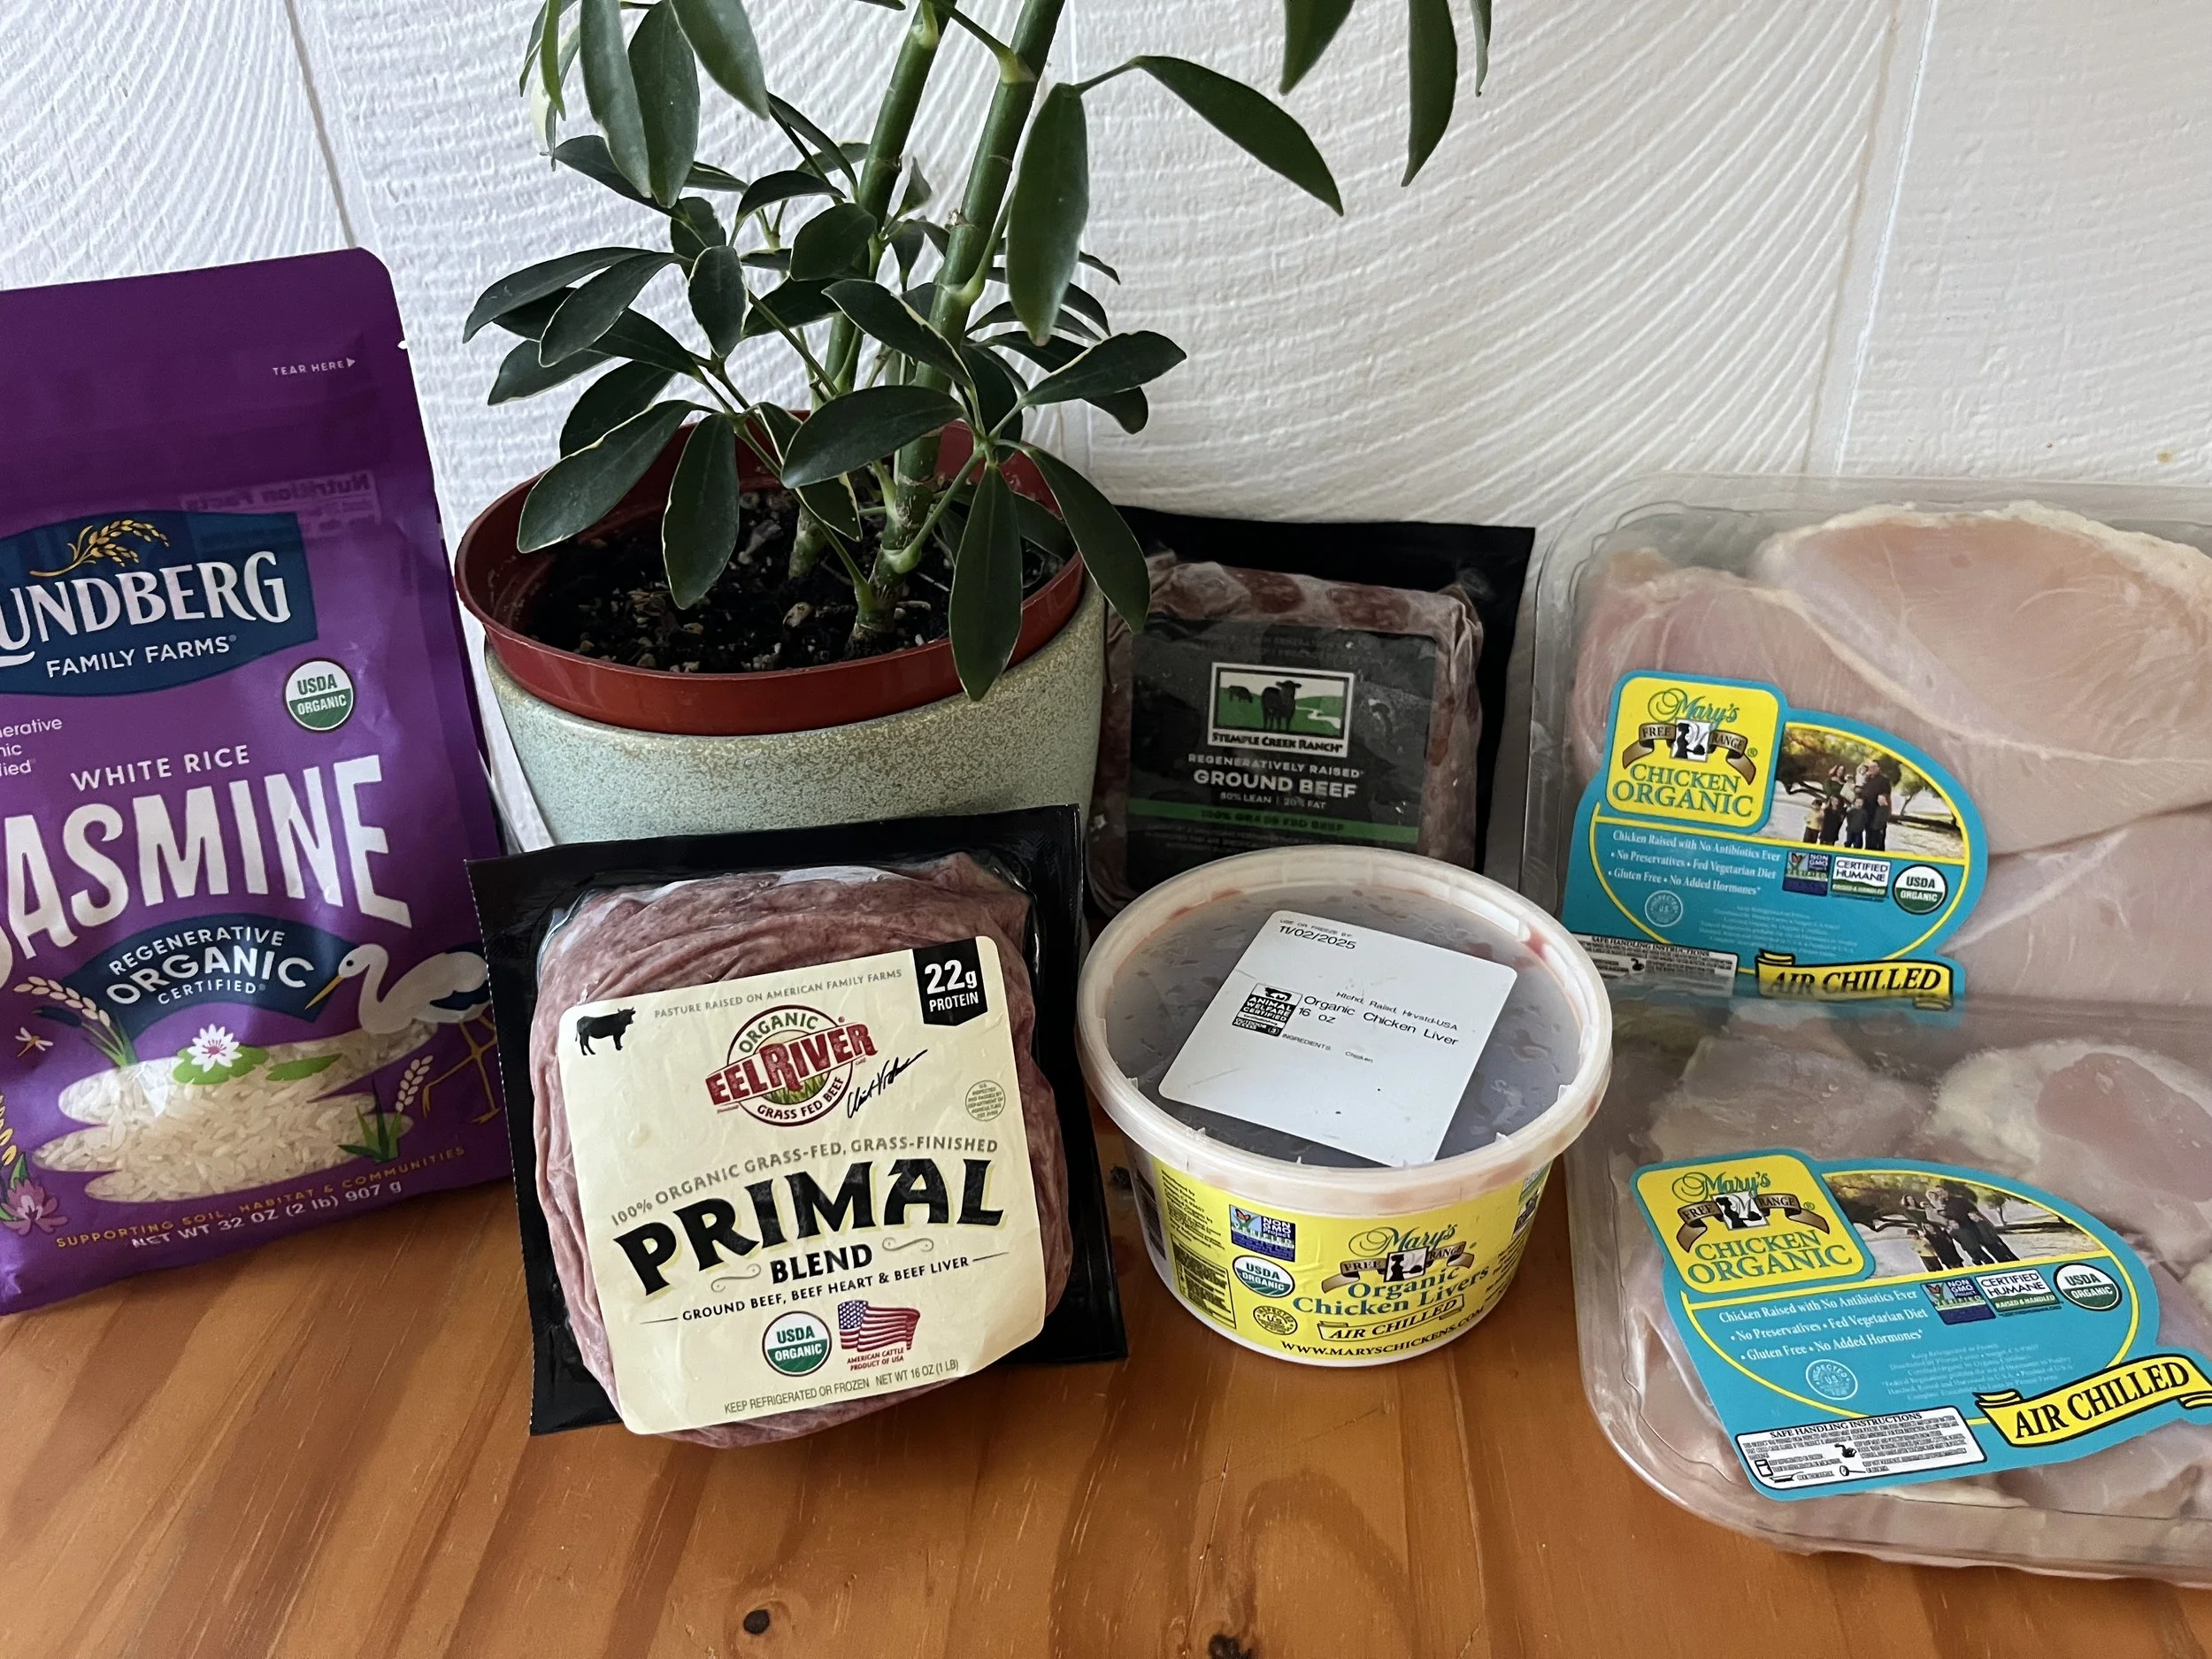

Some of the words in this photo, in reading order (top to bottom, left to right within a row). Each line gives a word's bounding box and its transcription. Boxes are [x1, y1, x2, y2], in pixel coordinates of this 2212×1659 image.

[273, 365, 306, 375] TEAR
[311, 360, 344, 372] HERE
[0, 551, 291, 665] UNDBERG
[46, 649, 134, 678] FAMILY
[146, 636, 230, 663] FARMS
[297, 673, 337, 695] USDA
[297, 695, 347, 715] ORGANIC
[1647, 687, 1740, 730] Mary's
[1212, 732, 1259, 746] STEMPLE
[1262, 736, 1296, 749] CREEK
[1642, 726, 1671, 738] FREE
[71, 758, 172, 791] WHITE
[184, 745, 250, 772] RICE
[1188, 753, 1305, 772] REGENERATIVELY
[1309, 764, 1360, 779] RAISED
[1630, 764, 1741, 794] CHICKEN
[1194, 769, 1293, 792] GROUND
[1299, 779, 1358, 798] BEEF
[1612, 780, 1754, 818] ORGANIC
[1613, 830, 1647, 843] Chicken
[1648, 834, 1677, 849] Raised
[1677, 839, 1698, 850] with
[1699, 841, 1711, 851] No
[1713, 843, 1760, 859] Antibiotics
[1761, 850, 1781, 862] Ever
[1617, 850, 1629, 860] No
[1630, 852, 1686, 867] Preservatives
[1692, 858, 1709, 869] Fed
[1709, 861, 1756, 877] Vegetarian
[1757, 867, 1777, 879] Diet
[1836, 870, 1885, 882] HUMANE
[1837, 859, 1888, 872] CERTIFIED
[1613, 867, 1642, 881] Gluten
[1643, 872, 1663, 884] Free
[1669, 874, 1681, 886] No
[1683, 877, 1711, 889] Added
[1906, 876, 1936, 888] USDA
[1901, 890, 1938, 902] ORGANIC
[109, 926, 285, 975] REGENERATIVE
[1279, 926, 1357, 949] 11/02/2025
[106, 945, 314, 1004] ORGANIC
[925, 959, 977, 995] 22g
[1822, 968, 1941, 991] CHILLED
[655, 1002, 702, 1018] PASTURE
[705, 996, 742, 1010] RAISED
[747, 993, 763, 1003] ON
[766, 982, 823, 1000] AMERICAN
[827, 976, 864, 990] FAMILY
[867, 969, 902, 982] FARMS
[929, 991, 979, 1012] PROTEIN
[1248, 996, 1292, 1012] ANIMAL
[1243, 1006, 1286, 1022] CERTIFIED
[1247, 1001, 1290, 1017] WELFARE
[1298, 1007, 1312, 1017] 16
[1303, 995, 1356, 1016] Organic
[1363, 1011, 1417, 1033] Chicken
[1423, 1028, 1459, 1046] Liver
[739, 1012, 818, 1053] ORGANIC
[757, 1103, 797, 1120] GRASS
[801, 1101, 823, 1117] FED
[824, 1076, 844, 1102] BEEF
[611, 1198, 653, 1226] 100%
[655, 1165, 740, 1205] ORGANIC
[744, 1142, 847, 1173] GRASS-FED,
[850, 1135, 998, 1153] GRASS-FINISHED
[1672, 1171, 1770, 1202] Mary's
[57, 1220, 174, 1248] SUPPORTING
[239, 1187, 315, 1213] HABITAT
[342, 1146, 466, 1189] COMMUNITIES
[1758, 1197, 1796, 1208] RANGE
[131, 1231, 171, 1248] NET
[178, 1222, 210, 1240] WT
[218, 1217, 244, 1232] 32
[250, 1208, 280, 1224] OZ
[311, 1194, 339, 1213] lb)
[344, 1184, 381, 1203] 907
[390, 1179, 403, 1194] g
[1263, 1217, 1290, 1229] NON
[1683, 1204, 1714, 1220] FREE
[612, 1157, 1004, 1297] PRIMAL
[1263, 1223, 1291, 1234] GMO
[1348, 1224, 1457, 1257] Mary's
[1429, 1244, 1462, 1260] RANGE
[1694, 1229, 1822, 1261] CHICKEN
[770, 1243, 872, 1284] BLEND
[1246, 1261, 1280, 1280] USDA
[1343, 1261, 1382, 1271] FREE
[1687, 1244, 1853, 1284] ORGANIC
[682, 1300, 745, 1321] GROUND
[750, 1293, 787, 1309] BEEF,
[791, 1286, 823, 1302] BEEF
[828, 1275, 873, 1294] HEART
[879, 1272, 889, 1284] &
[894, 1265, 926, 1281] BEEF
[930, 1256, 969, 1274] LIVER
[1241, 1271, 1285, 1291] ORGANIC
[1293, 1296, 1409, 1316] Chicken
[1419, 1266, 1489, 1305] Livers
[1348, 1266, 1460, 1300] Organic
[1980, 1273, 2039, 1287] CERTIFIED
[1987, 1282, 2046, 1297] HUMANE
[2064, 1273, 2101, 1286] USDA
[2071, 1286, 2113, 1299] ORGANIC
[1718, 1307, 1764, 1323] Chicken
[1763, 1302, 1796, 1317] Raised
[1797, 1299, 1822, 1312] with
[1822, 1297, 1838, 1310] No
[1839, 1290, 1893, 1308] Antibiotics
[1895, 1288, 1918, 1302] Ever
[2024, 1294, 2055, 1304] HANDLED
[1281, 1306, 1485, 1356] WWW.MARYSCHICKENS.COM
[1329, 1329, 1366, 1340] AIR
[1372, 1299, 1457, 1336] CHILLED
[1735, 1329, 1753, 1341] No
[1754, 1321, 1822, 1339] Preservatives
[1828, 1317, 1848, 1330] Fed
[1849, 1310, 1904, 1327] Vegetarian
[1904, 1307, 1928, 1320] Diet
[776, 1325, 816, 1344] USDA
[1747, 1346, 1782, 1361] Gluten
[1783, 1343, 1808, 1356] Free
[1813, 1340, 1832, 1353] No
[1832, 1334, 1867, 1350] Added
[774, 1342, 823, 1362] ORGANIC
[846, 1351, 880, 1364] AMERICAN
[881, 1347, 904, 1358] CATTLE
[850, 1360, 880, 1371] PRODUCT
[891, 1355, 904, 1363] USA
[724, 1401, 748, 1414] KEEP
[749, 1387, 817, 1409] REFRIGERATED
[818, 1386, 833, 1396] OR
[834, 1377, 870, 1393] FROZEN
[875, 1373, 893, 1386] NET
[895, 1371, 909, 1382] WT
[922, 1364, 934, 1376] OZ
[945, 1359, 959, 1372] LB)
[2015, 1403, 2070, 1439] AIR
[2067, 1361, 2190, 1421] CHILLED
[1770, 1428, 1794, 1439] SAFE
[1795, 1423, 1849, 1436] HANDLING
[1849, 1413, 1923, 1429] INSTRUCTIONS
